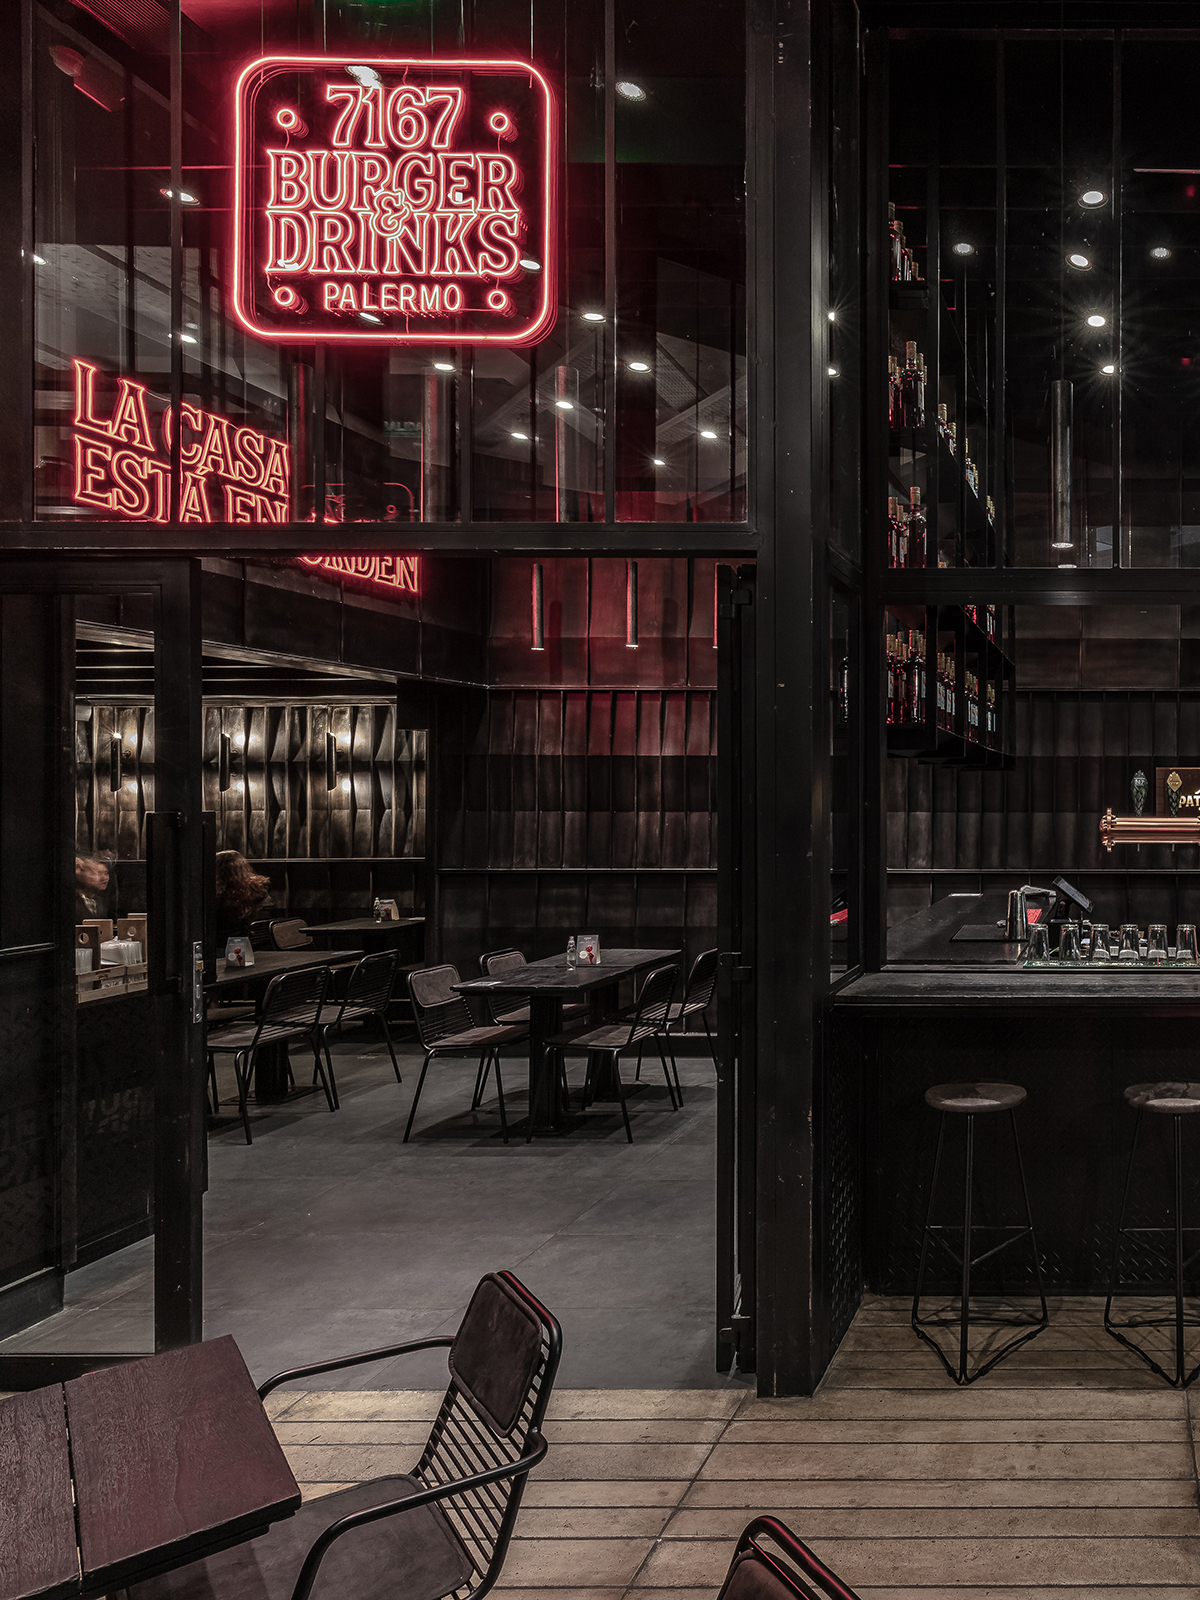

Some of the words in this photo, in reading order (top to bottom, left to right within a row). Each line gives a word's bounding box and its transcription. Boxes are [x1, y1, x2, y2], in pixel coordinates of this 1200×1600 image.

[326, 84, 463, 149] 7167
[266, 149, 520, 213] BURGER
[265, 210, 520, 277] DRINKS
[371, 191, 412, 238] &
[324, 282, 463, 311] PALERMO
[74, 360, 154, 451] LA
[163, 403, 289, 498] CASA
[223, 485, 289, 523] EN
